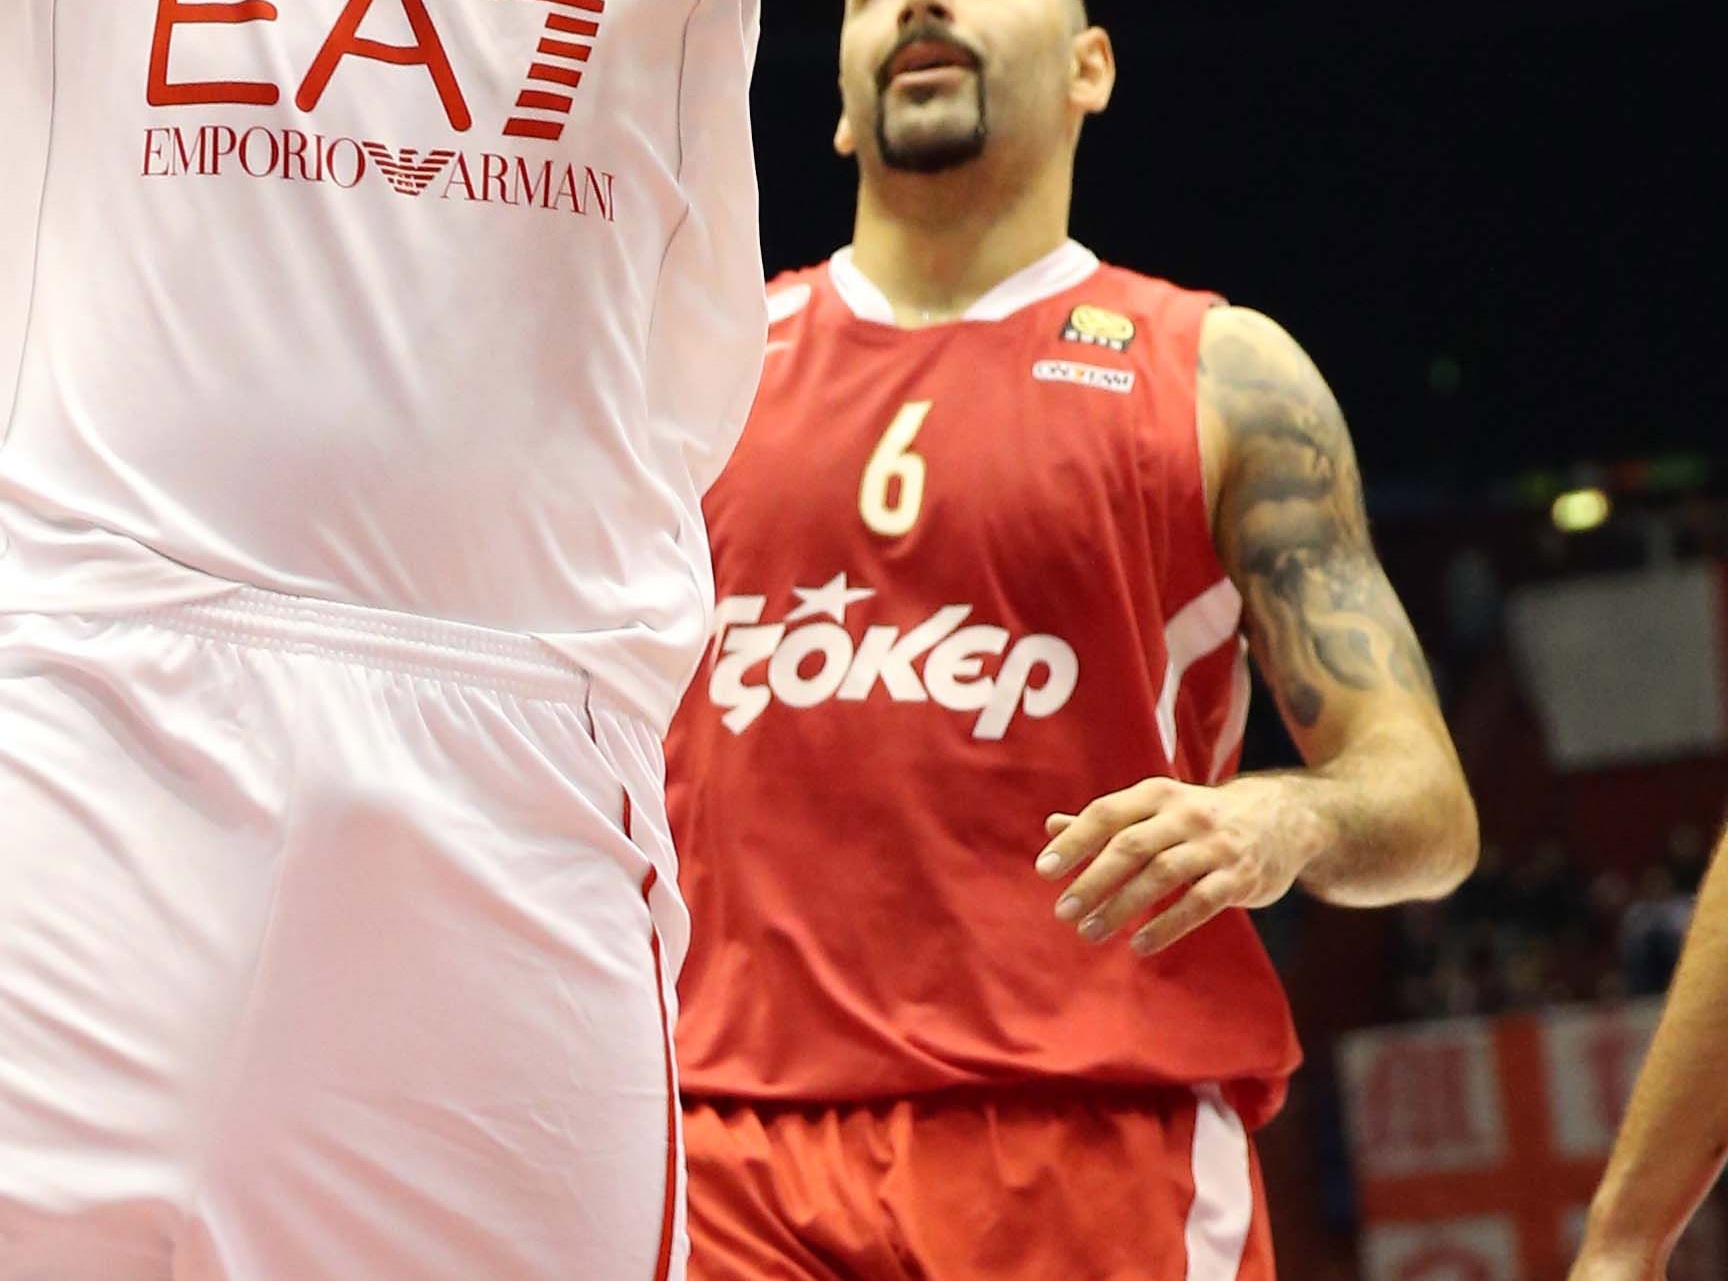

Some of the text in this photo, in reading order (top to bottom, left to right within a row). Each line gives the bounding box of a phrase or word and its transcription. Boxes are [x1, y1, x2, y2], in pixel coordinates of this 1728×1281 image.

[140, 125, 615, 222] EMPORIO ARMANI
[857, 400, 932, 537] 6
